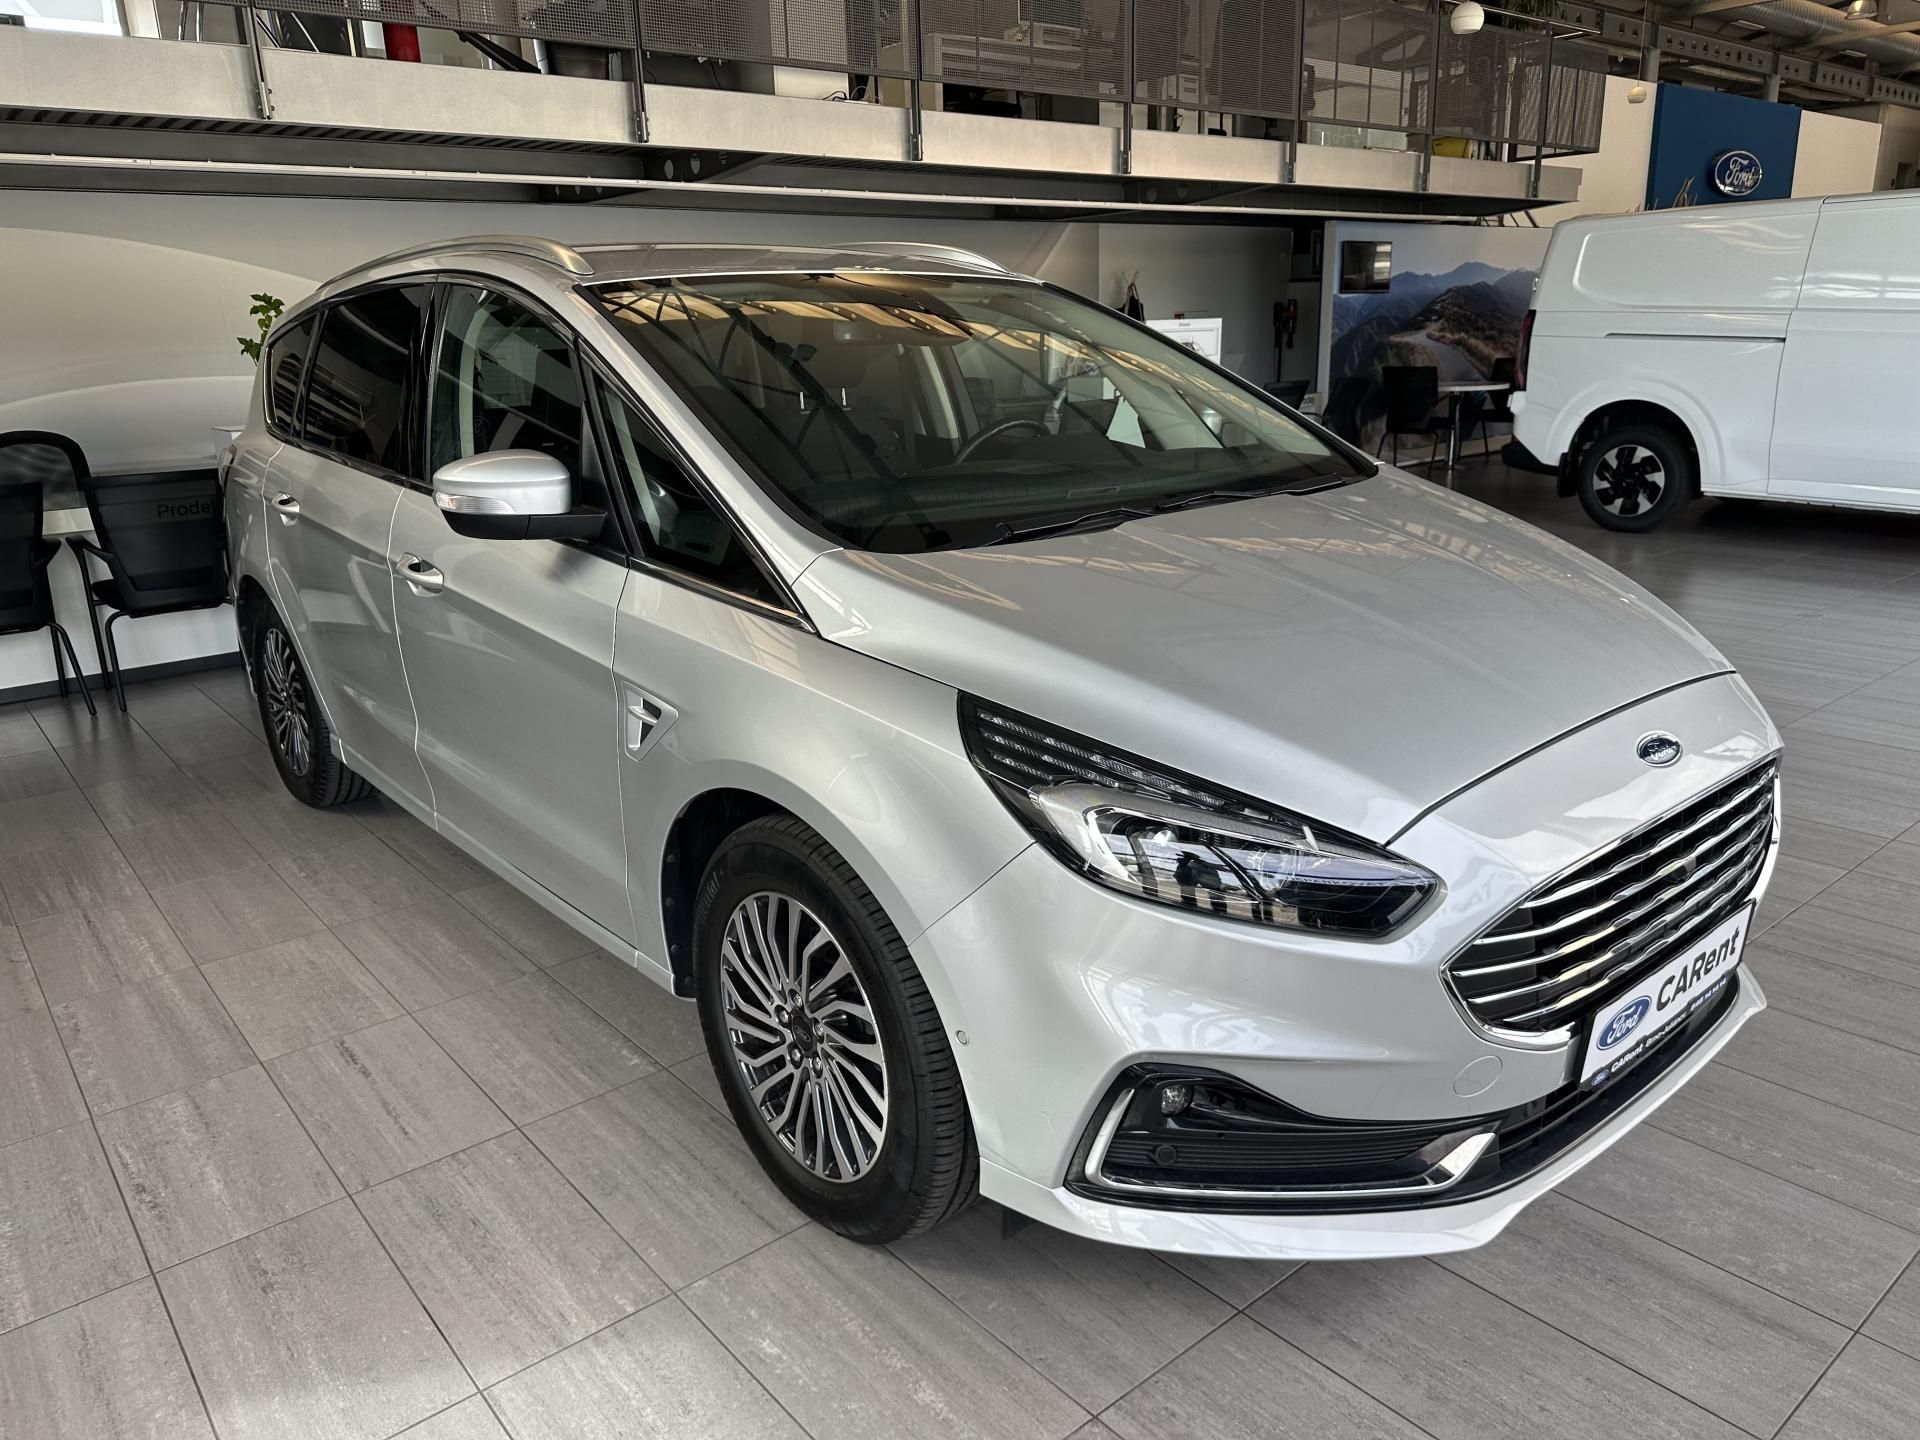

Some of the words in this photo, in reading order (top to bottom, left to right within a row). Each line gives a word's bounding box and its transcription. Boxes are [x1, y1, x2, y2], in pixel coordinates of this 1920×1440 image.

[1606, 1004, 1643, 1044] Ford
[1656, 926, 1740, 1012] CARent
[1611, 1043, 1644, 1072] CARent
